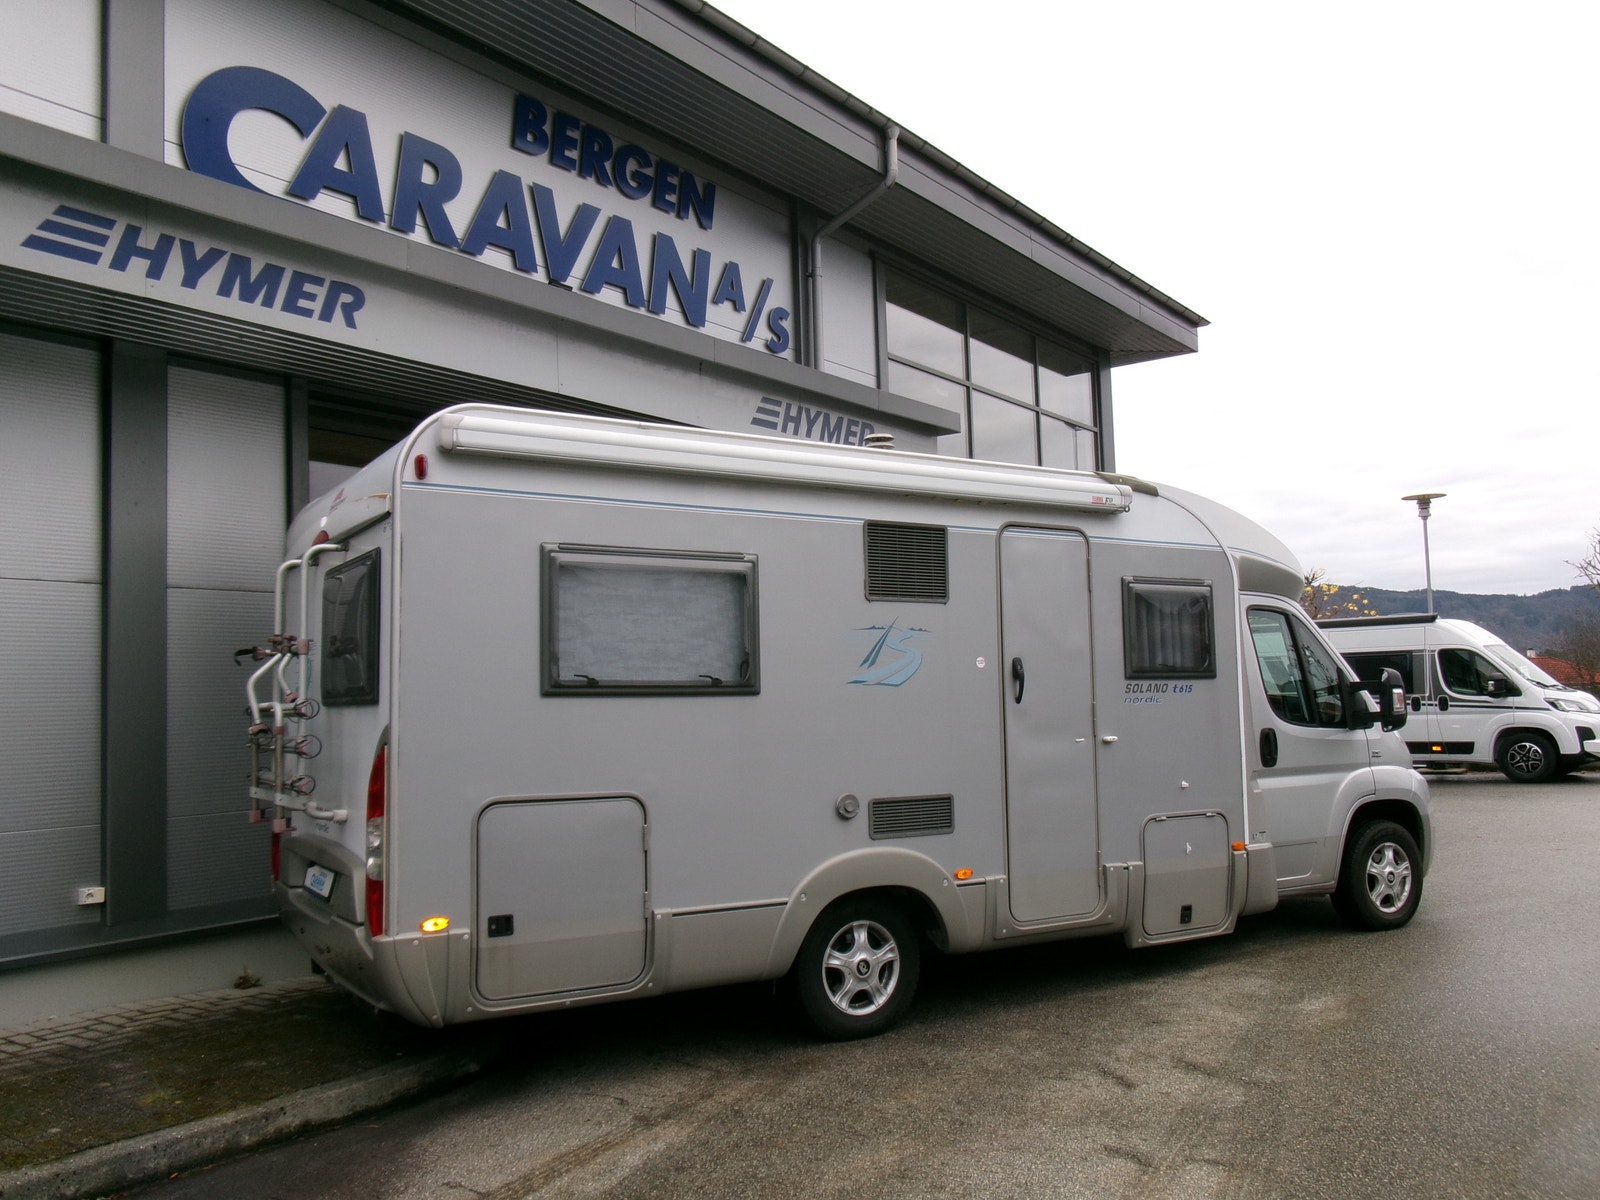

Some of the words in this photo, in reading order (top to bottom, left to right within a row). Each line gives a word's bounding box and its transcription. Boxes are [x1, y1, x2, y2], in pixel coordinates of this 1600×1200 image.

[181, 65, 712, 329] CARAVAN
[713, 260, 791, 354] A/S
[512, 93, 716, 231] BERGEN
[108, 222, 366, 330] HYMER
[1124, 683, 1169, 694] SOLANO
[1172, 684, 1193, 694] t615
